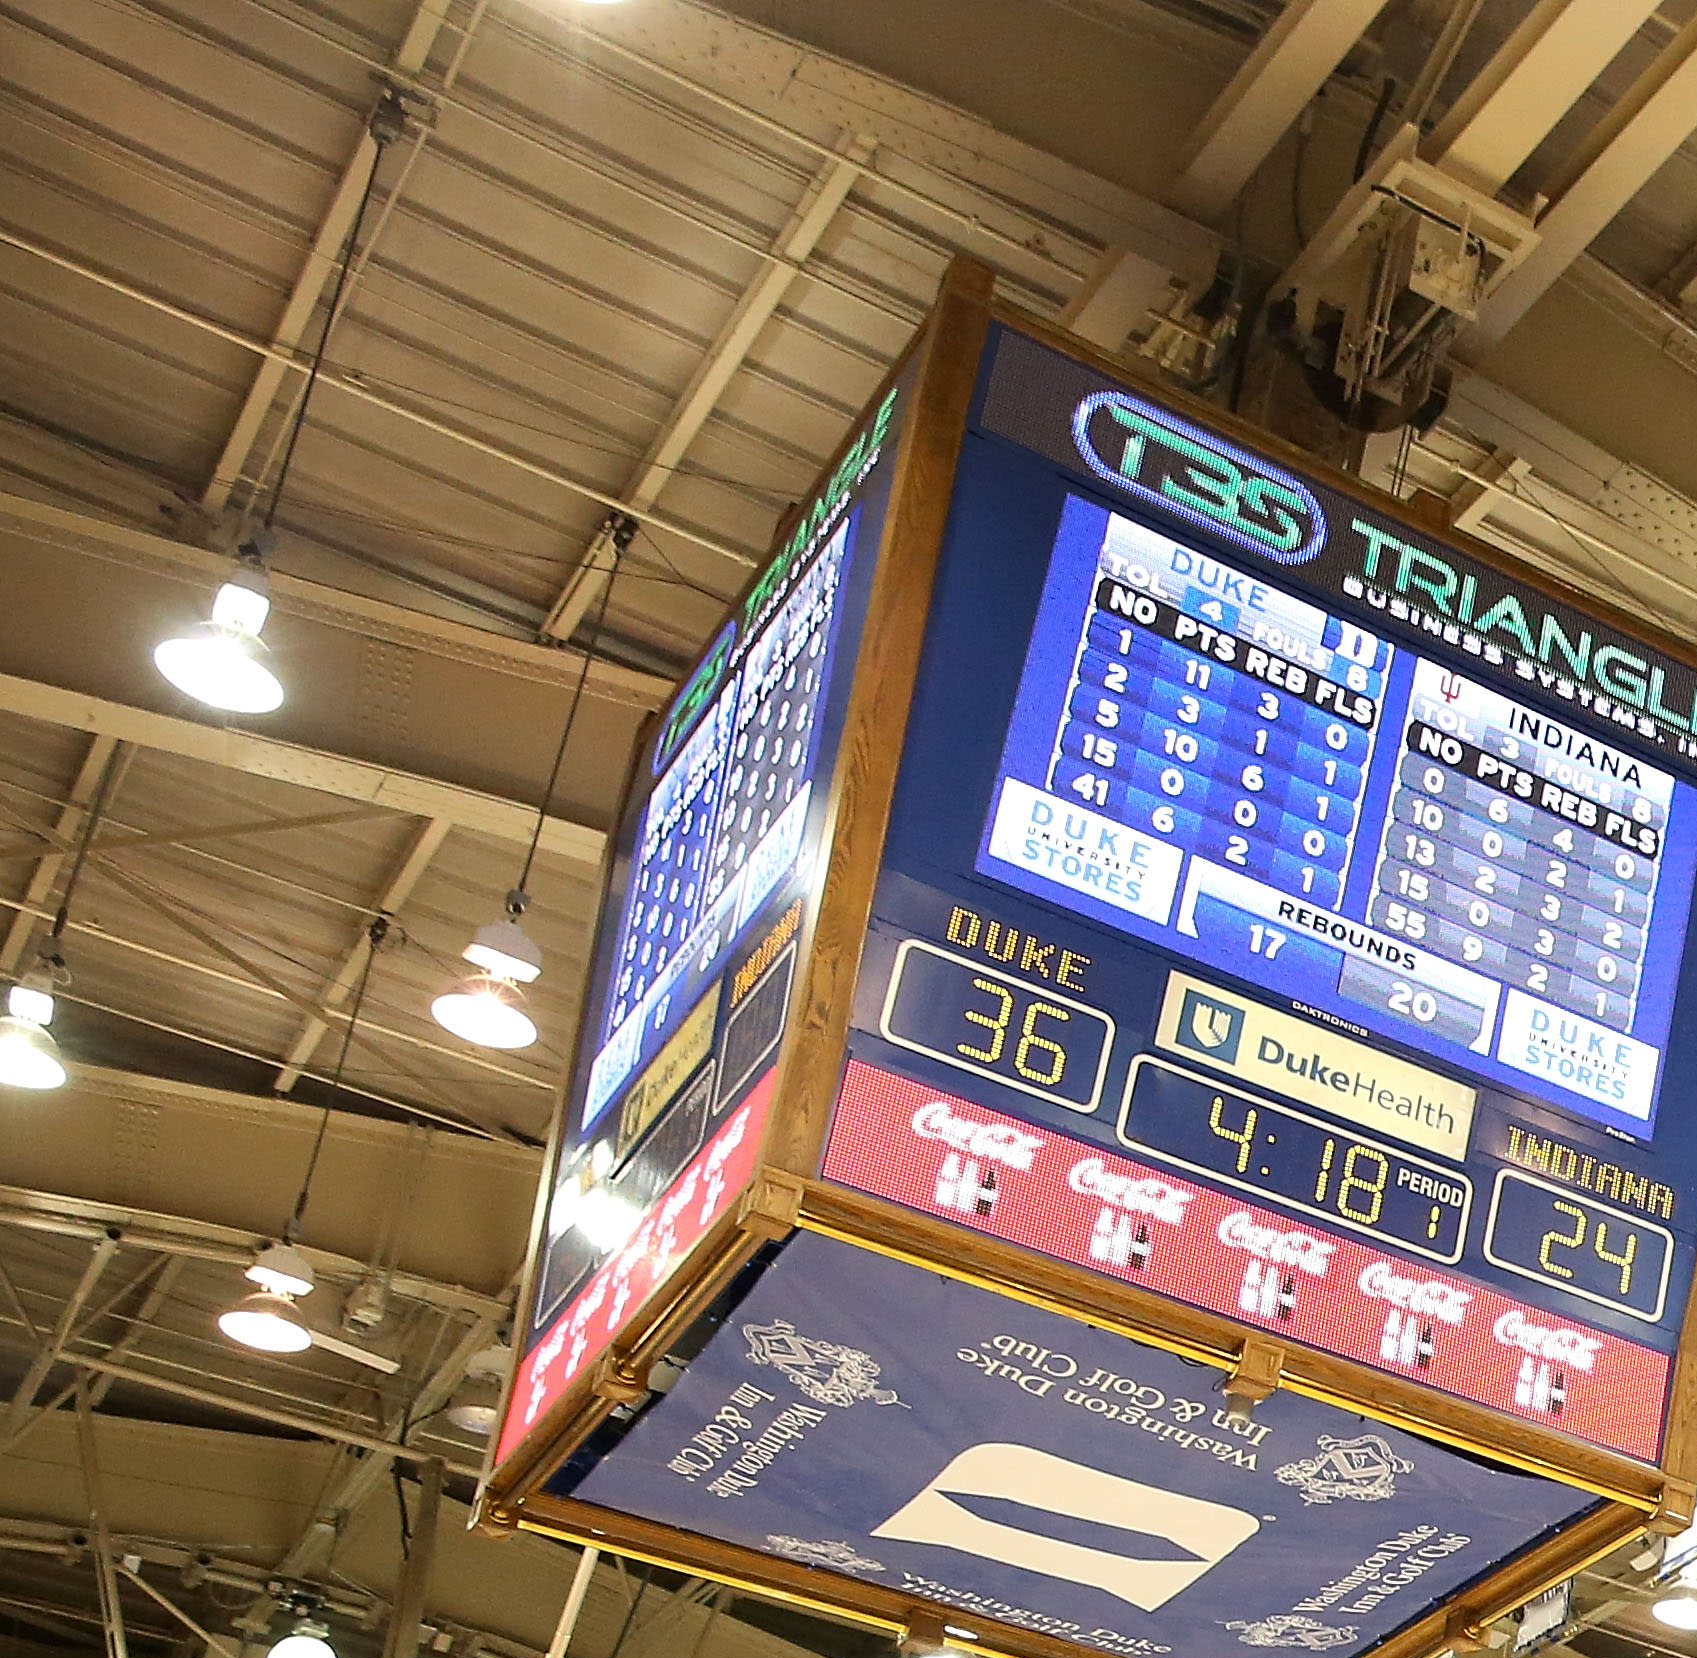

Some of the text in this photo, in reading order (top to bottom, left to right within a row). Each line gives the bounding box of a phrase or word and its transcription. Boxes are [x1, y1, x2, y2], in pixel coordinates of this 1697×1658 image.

[1171, 547, 1270, 612] DUKE
[1105, 554, 1369, 692] TOL 4 FOULS 8
[1117, 628, 1132, 656] 1
[1342, 576, 1504, 666] BUSINESS
[1103, 663, 1129, 692] 2
[1109, 585, 1375, 725] NO PTS REB FLS
[1095, 699, 1120, 729] 5
[1081, 733, 1118, 769] 15
[1418, 697, 1653, 823] TOL 3 FOULS 8
[1509, 706, 1642, 790] INDIANA
[1072, 774, 1111, 807] 41
[1418, 726, 1659, 855] NO PTS REB FLS
[1422, 766, 1446, 794] 0
[1031, 799, 1152, 870] DUKE
[1410, 798, 1445, 832] 10
[1021, 840, 1143, 903] STORES
[1026, 825, 1147, 881] UNIVERSITY
[1404, 832, 1437, 867] 13
[1397, 867, 1431, 902] 15
[946, 905, 1093, 992] DUKE
[1278, 899, 1417, 972] REBOUNDS
[1384, 901, 1428, 940] 55
[1249, 923, 1438, 1023] 17 20
[956, 978, 1071, 1086] 36
[1291, 1000, 1370, 1037] DAKTRONICS
[1531, 1007, 1633, 1070] DUKE
[1257, 1034, 1456, 1135] DukeHealth
[1525, 1044, 1626, 1100] STORES
[1527, 1031, 1630, 1080] UNIVERSITY
[1208, 1096, 1390, 1225] 4:18
[1397, 1166, 1465, 1206] PERIOD
[1503, 1124, 1677, 1220] INDIANA
[1428, 1205, 1441, 1240] 1
[1539, 1200, 1638, 1295] 24
[992, 1334, 1078, 1378] Club
[956, 1347, 1258, 1472] Washington Duke
[1078, 1367, 1165, 1410] Golf
[1170, 1397, 1206, 1423] &
[1292, 1524, 1439, 1613] Washington Duke
